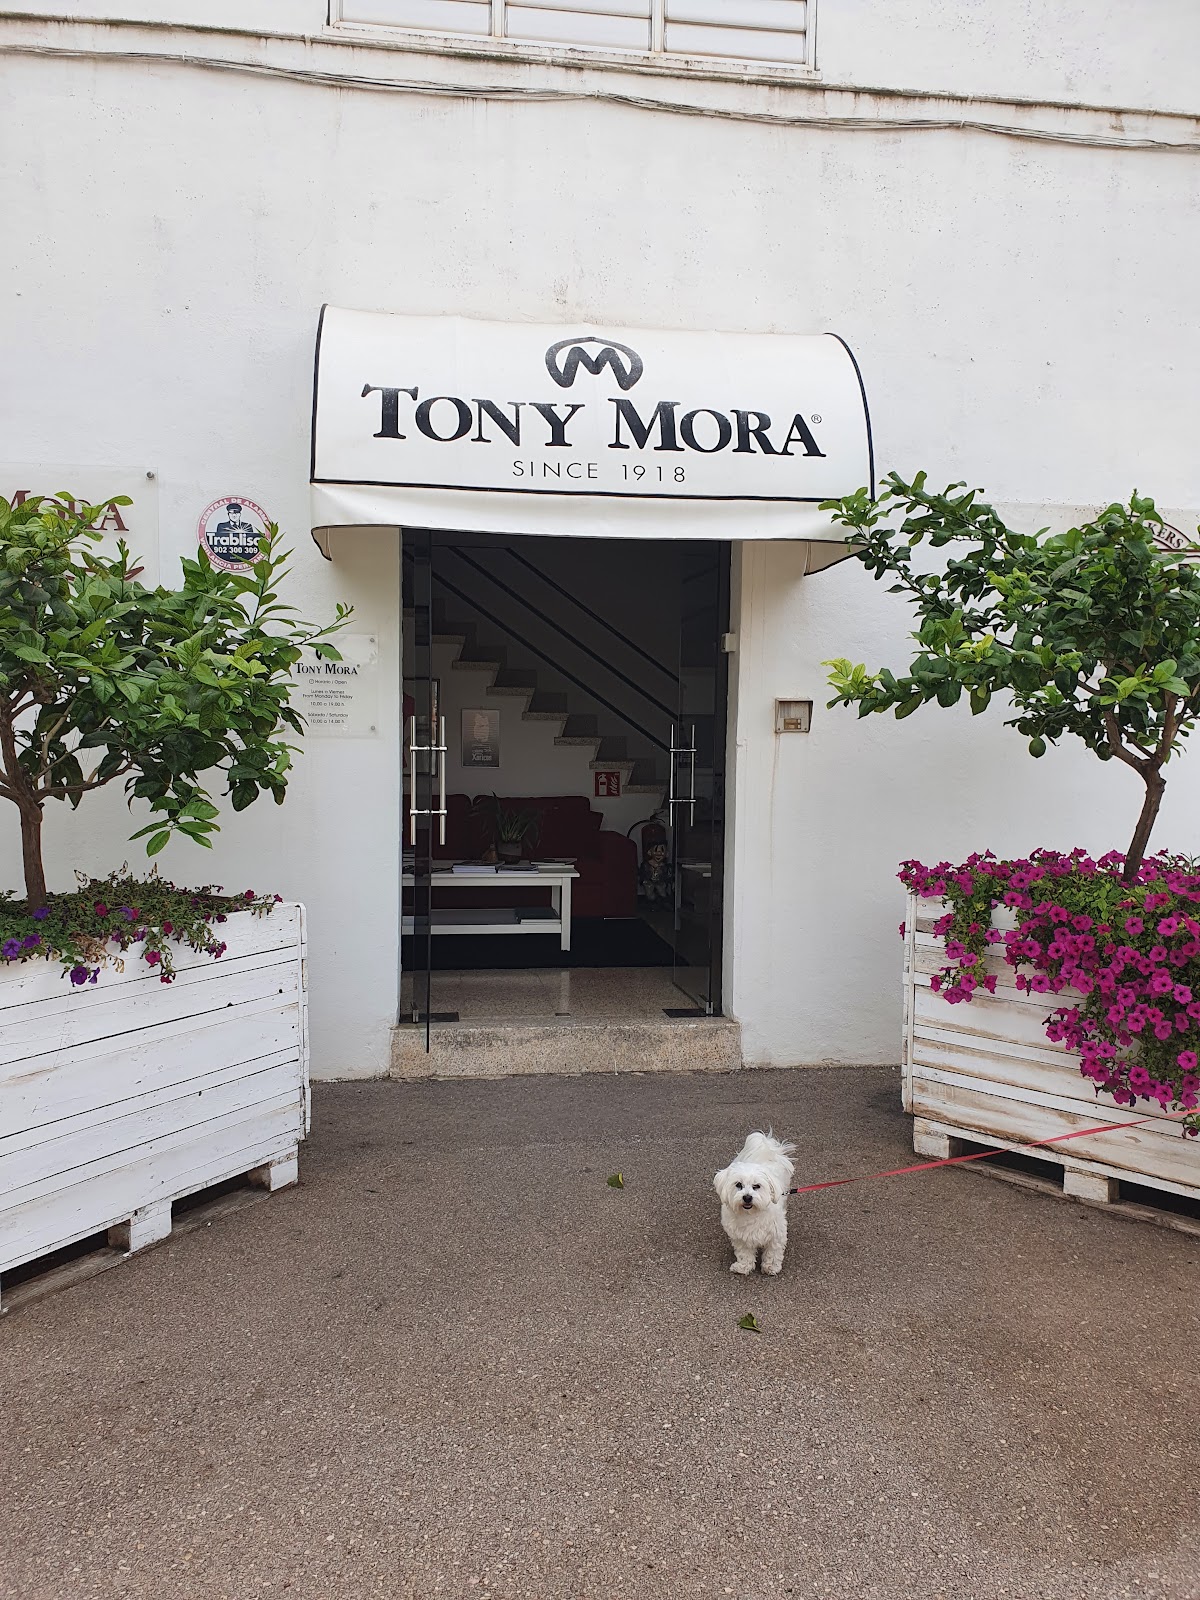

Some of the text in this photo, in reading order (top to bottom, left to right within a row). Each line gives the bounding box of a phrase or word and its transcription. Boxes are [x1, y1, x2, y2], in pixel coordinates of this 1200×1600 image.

[361, 383, 585, 447] TONY
[512, 460, 685, 483] SINCE 1918
[201, 499, 230, 525] CENTRAL
[295, 662, 322, 674] TONY
